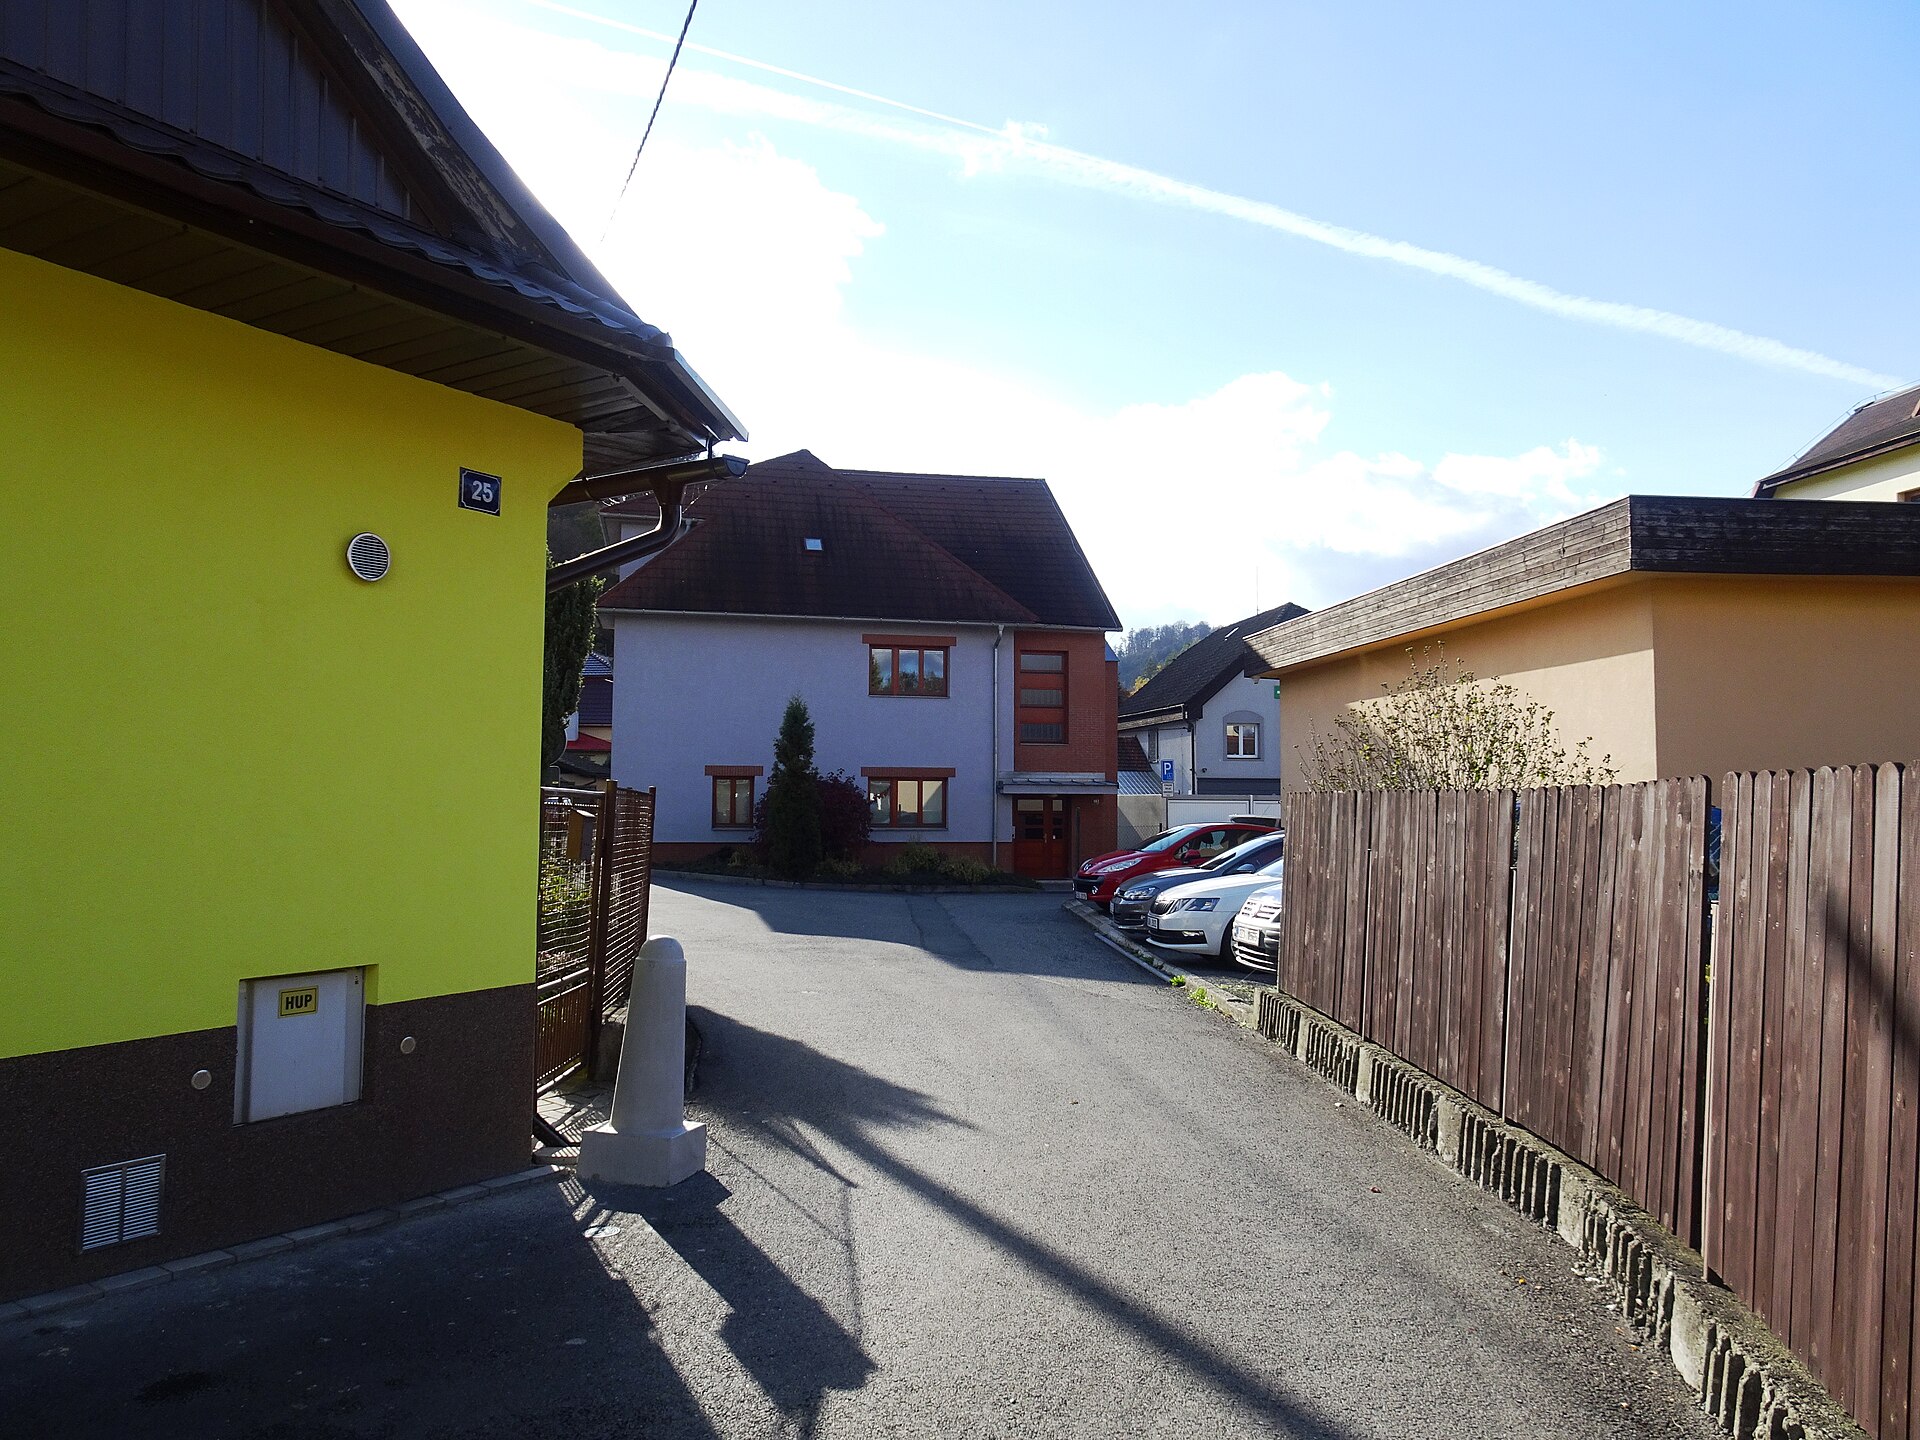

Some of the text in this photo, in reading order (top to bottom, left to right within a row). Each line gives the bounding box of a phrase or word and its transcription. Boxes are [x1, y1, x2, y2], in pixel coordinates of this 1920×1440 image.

[471, 480, 493, 503] 25
[1163, 762, 1172, 775] P
[285, 994, 313, 1010] HUP
